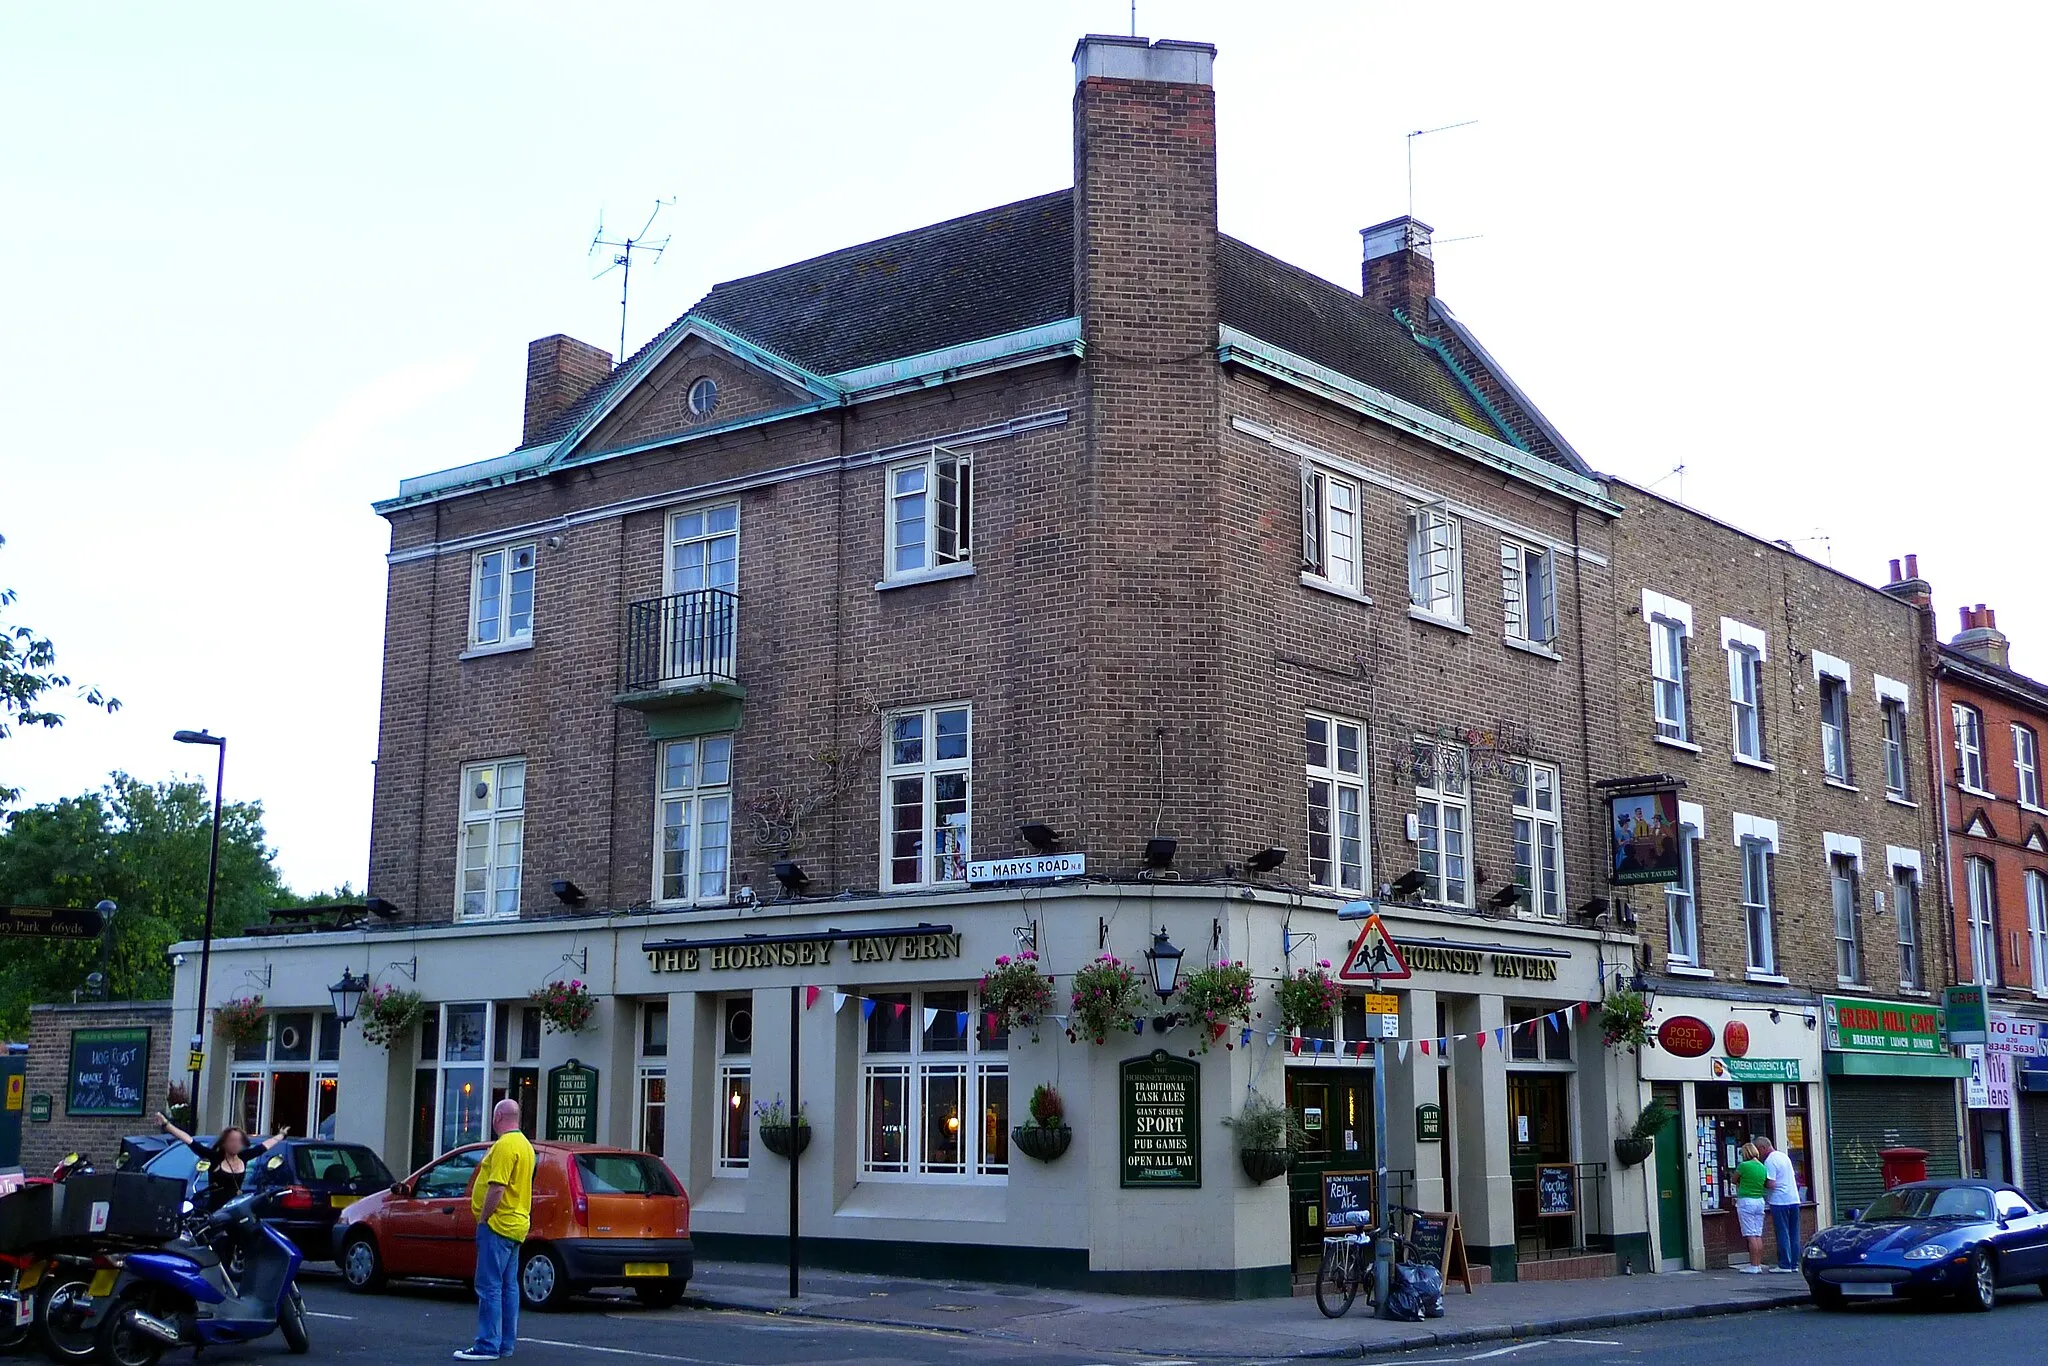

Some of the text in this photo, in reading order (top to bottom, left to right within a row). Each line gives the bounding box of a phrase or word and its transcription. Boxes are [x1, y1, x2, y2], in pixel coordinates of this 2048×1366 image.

[971, 866, 988, 878] ST.
[992, 862, 1032, 877] MARYS
[1037, 859, 1069, 873] ROAD
[1618, 869, 1677, 880] HORNSEY TAVERN
[16, 920, 40, 933] Park
[51, 922, 83, 936] 66yds
[648, 932, 962, 973] THE HORNSEY TAVERN
[1401, 945, 1558, 980] HORNSEY TAVERN
[1839, 1007, 1879, 1030] GREEN
[1882, 1010, 1908, 1033] HILL
[1910, 1013, 1936, 1035] CAFE
[1670, 1026, 1699, 1038] POST
[1990, 1021, 2007, 1034] TO
[2012, 1023, 2036, 1036] LET
[1666, 1037, 1703, 1050] OFFICE
[1852, 1034, 1885, 1047] BREAKFAST
[1890, 1036, 1909, 1048] LUNCH
[1913, 1038, 1934, 1049] DINNER
[1988, 1043, 2011, 1051] 8348
[2013, 1044, 2035, 1054] 5639
[1730, 1060, 1753, 1070] FOREIGN
[1753, 1060, 1779, 1071] CURRENCY
[560, 1081, 587, 1089] CASK ALES
[1134, 1082, 1186, 1091] TRADITIONAL
[558, 1094, 587, 1107] SKY TV
[1135, 1091, 1185, 1102] CASK ALES
[1136, 1108, 1184, 1116] GIANT SCREEN
[557, 1115, 586, 1129] SPORT
[1137, 1116, 1184, 1133] SPORT
[1134, 1139, 1187, 1149] PUB GAMES
[1128, 1155, 1194, 1166] OPEN ALL DAY
[1331, 1182, 1351, 1199] REAL
[1341, 1194, 1358, 1209] ALE
[1551, 1193, 1569, 1206] BAR
